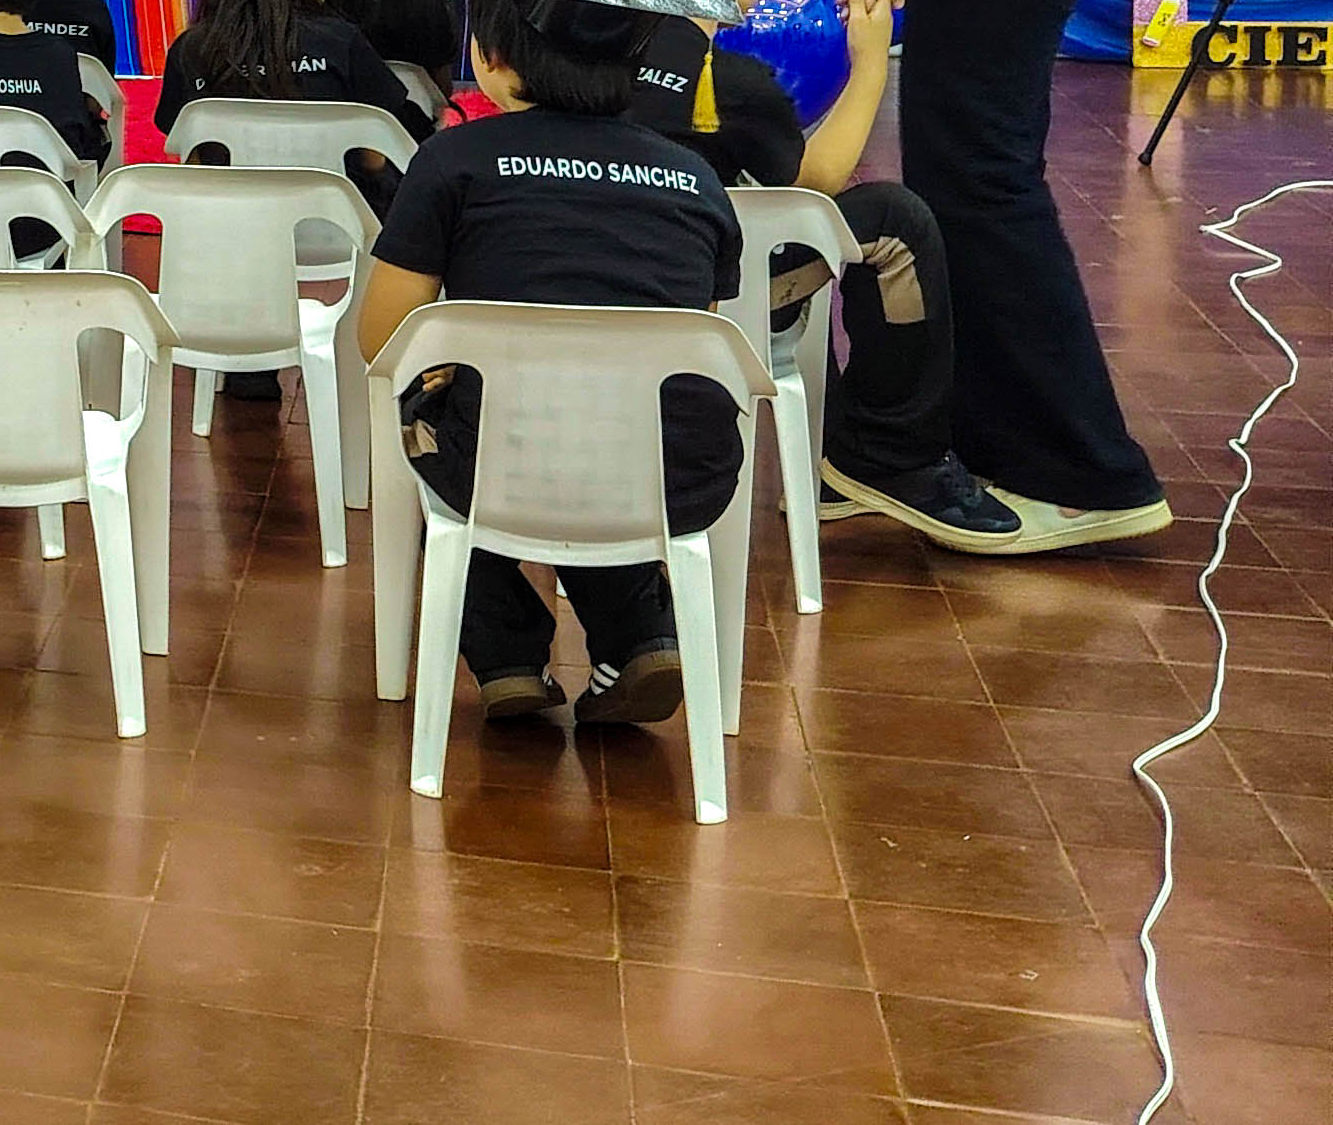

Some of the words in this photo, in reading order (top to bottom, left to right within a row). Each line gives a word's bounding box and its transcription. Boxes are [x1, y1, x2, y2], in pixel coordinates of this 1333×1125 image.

[1190, 24, 1329, 68] CIE
[497, 156, 603, 181] EDUARDO
[607, 162, 700, 195] SANCHEZ
